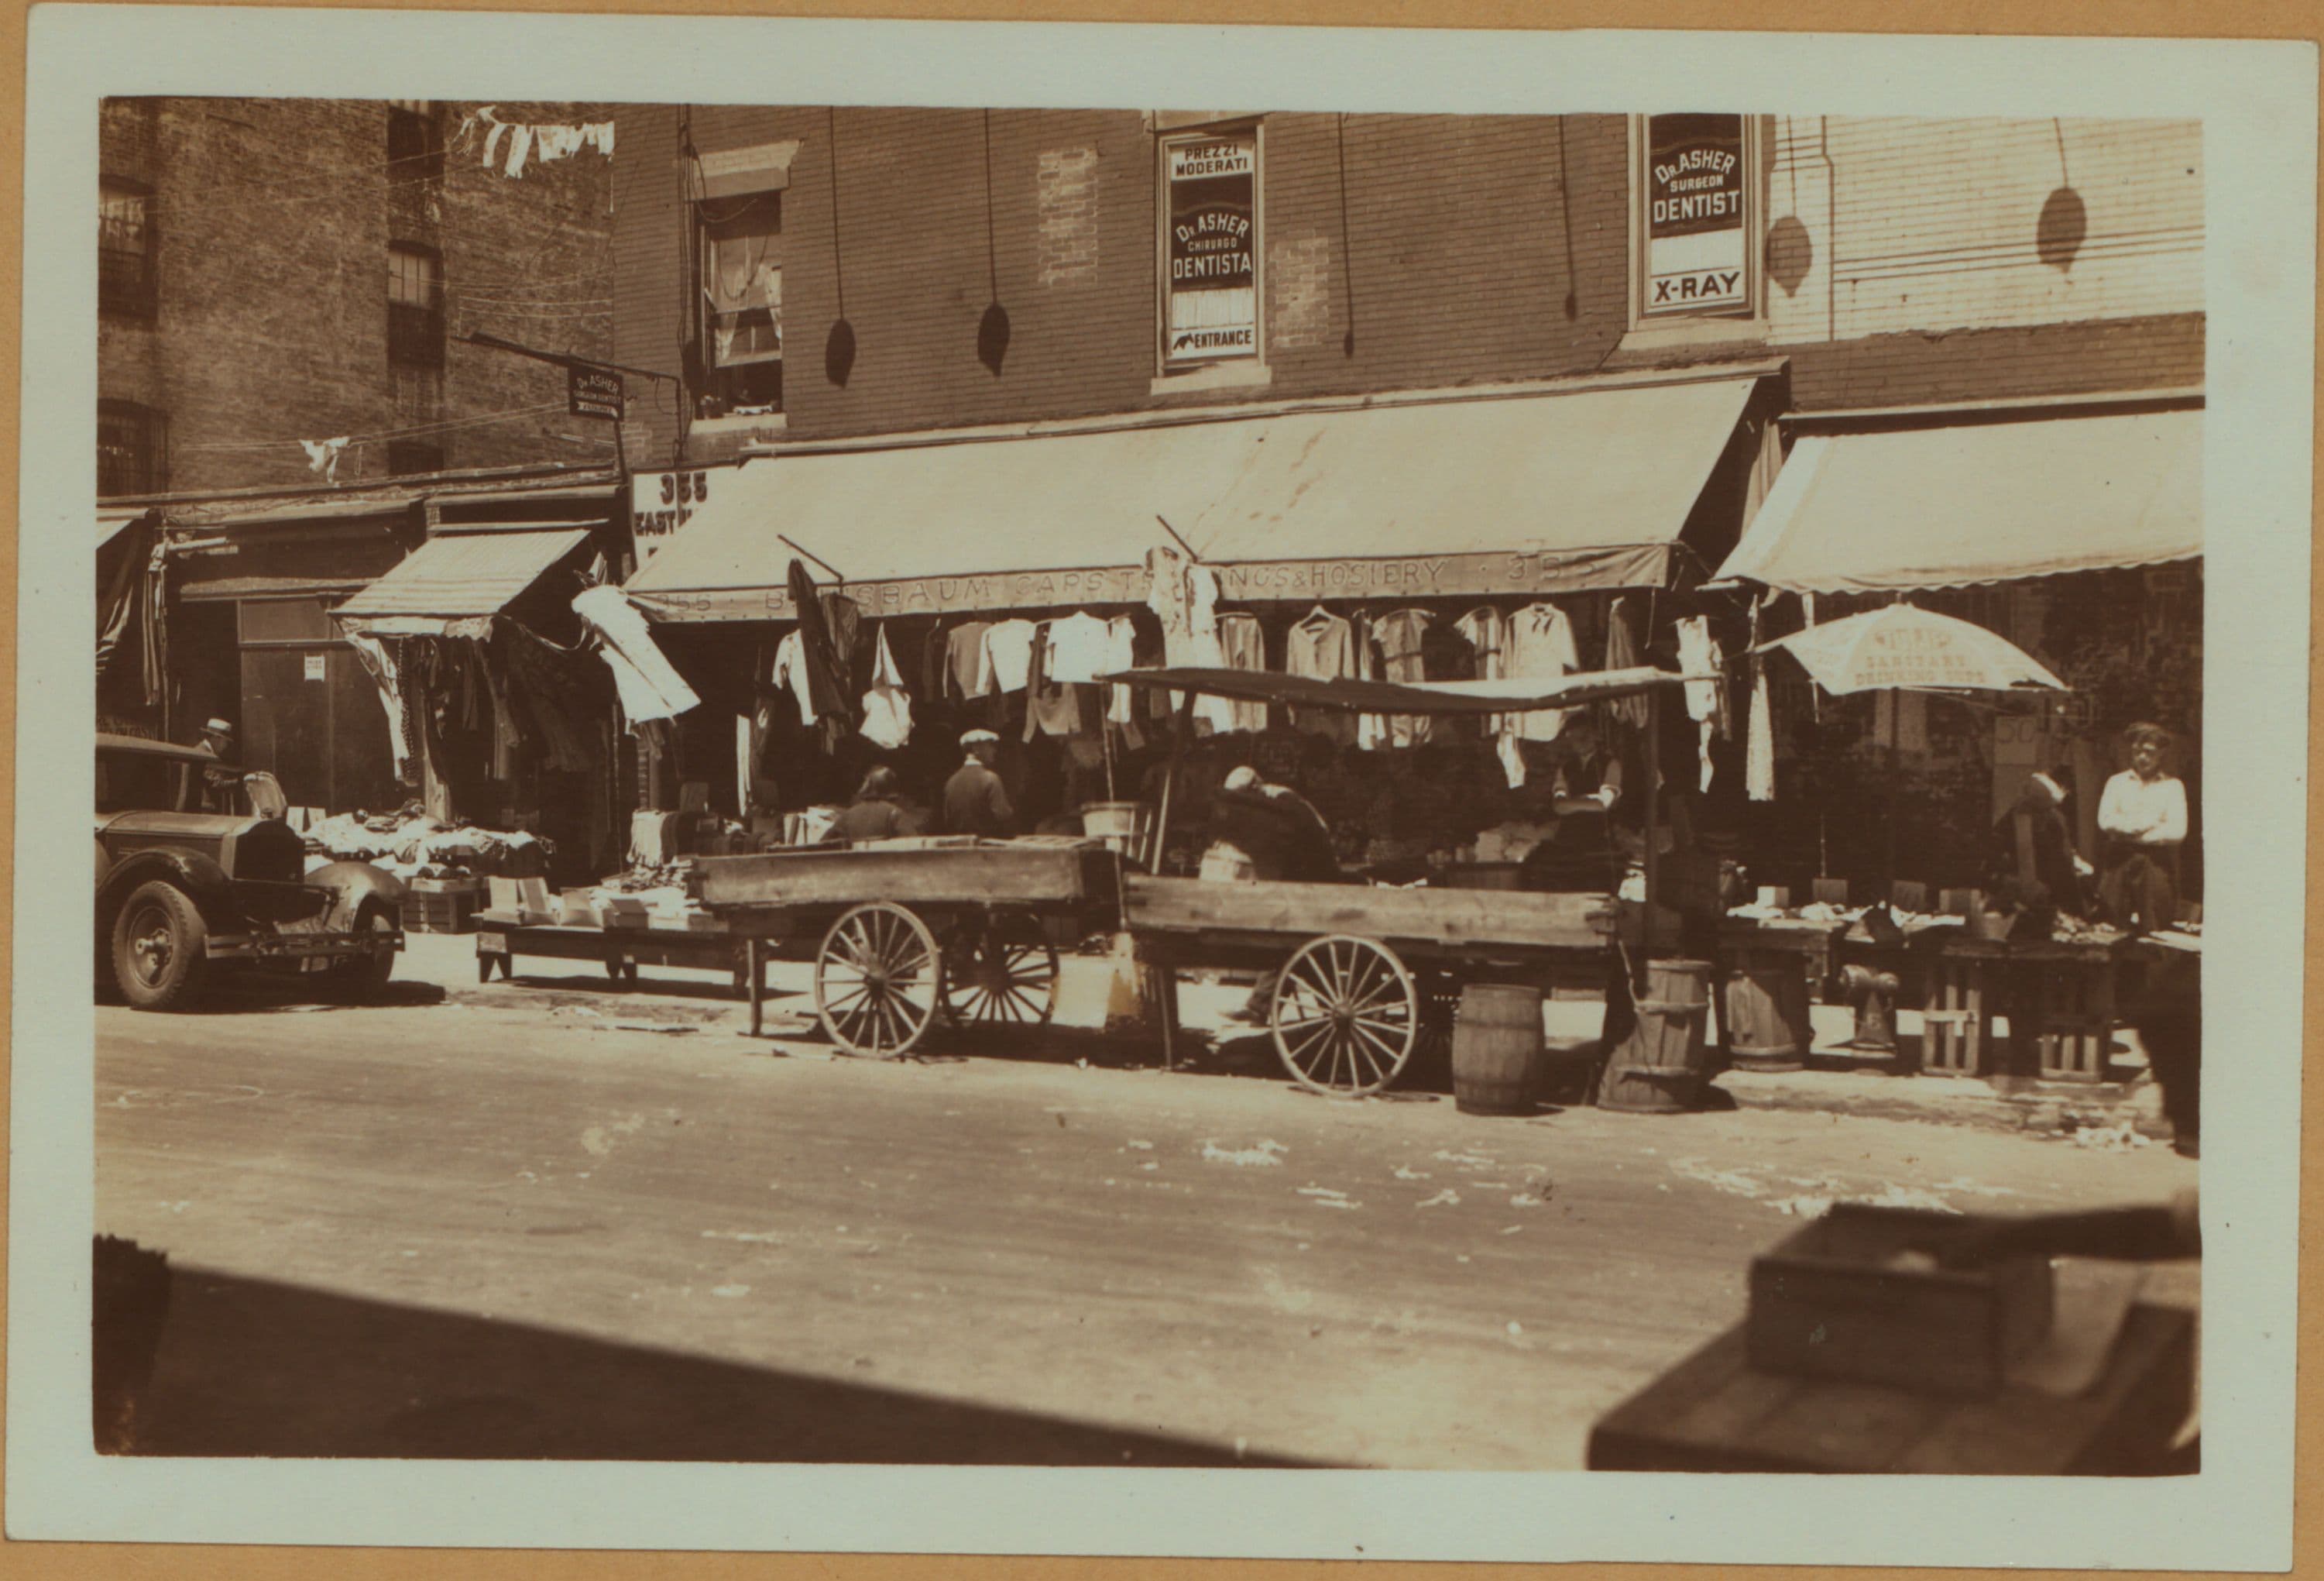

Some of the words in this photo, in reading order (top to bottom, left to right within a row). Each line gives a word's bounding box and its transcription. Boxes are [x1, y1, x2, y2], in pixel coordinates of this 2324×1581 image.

[1185, 144, 1238, 160] PREZZI
[1678, 150, 1735, 174] ASHER
[1176, 157, 1248, 177] MODERATI
[1670, 174, 1724, 193] SURGEON
[1653, 190, 1740, 223] DENTIST
[1197, 213, 1249, 239] ASHER
[1188, 237, 1238, 253] CHIRURGO
[1173, 252, 1252, 279] DENTISTA
[1654, 271, 1741, 302] X-RAY
[1194, 329, 1252, 349] ENTRANCE
[590, 375, 619, 396] ASHER
[661, 472, 707, 504] 355
[633, 510, 676, 537] EAST
[1015, 572, 1105, 596] CAPS
